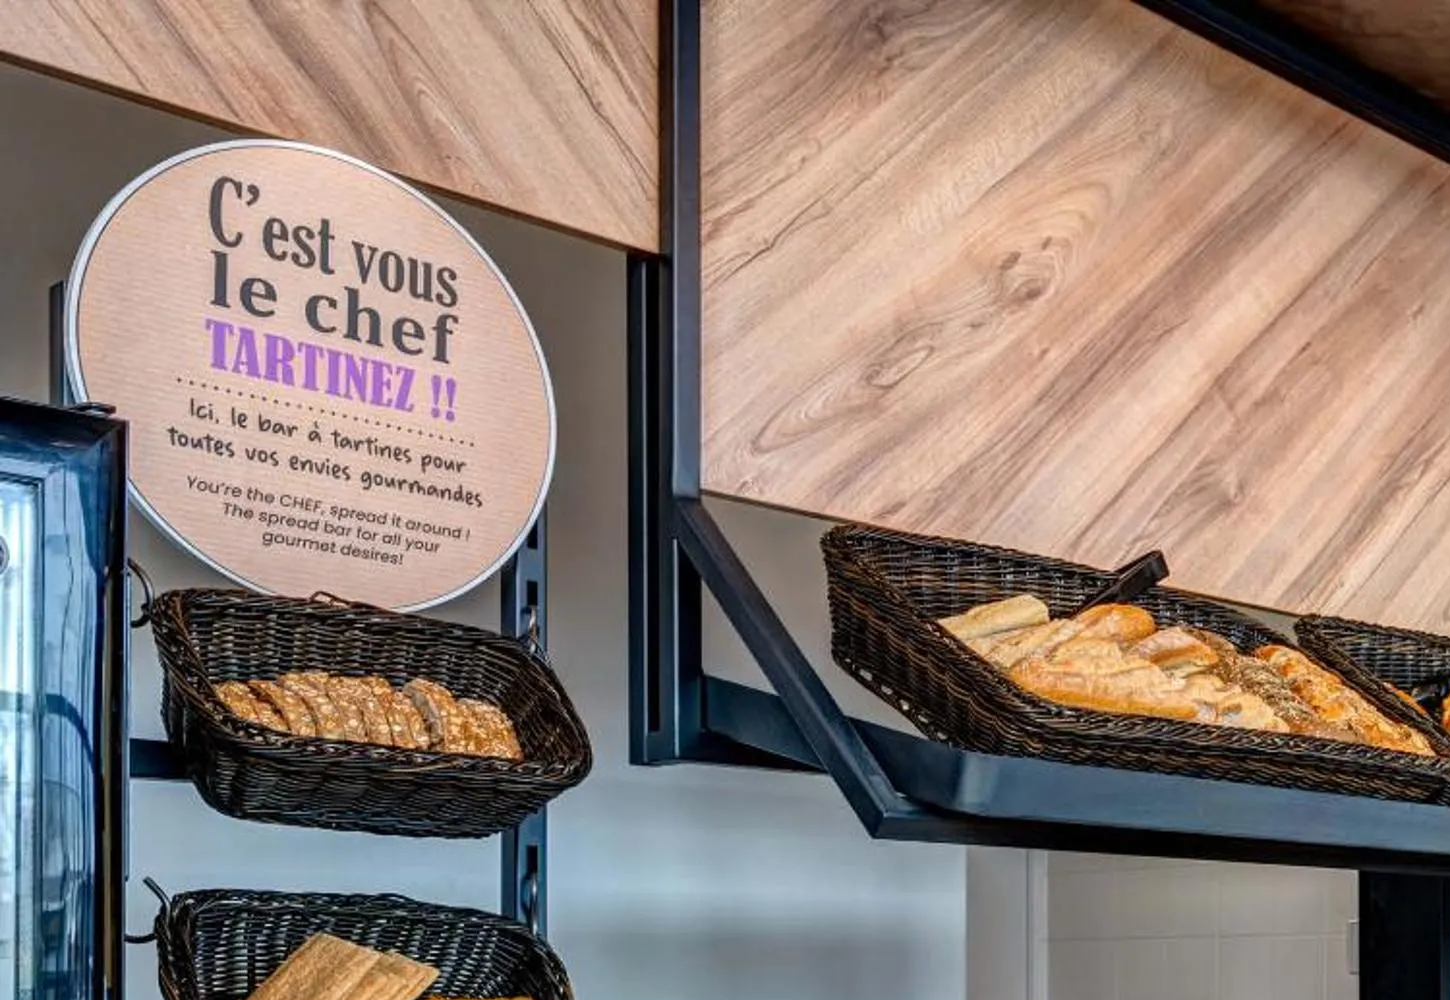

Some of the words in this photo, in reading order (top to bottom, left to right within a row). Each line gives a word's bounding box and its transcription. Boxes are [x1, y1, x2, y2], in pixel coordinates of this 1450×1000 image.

[209, 176, 335, 274] C'est
[352, 241, 458, 307] vous
[210, 250, 278, 317] le
[305, 286, 459, 364] chef
[205, 318, 416, 412] TARTINEZ
[431, 375, 456, 422] !!
[167, 426, 235, 458] toutes
[245, 448, 279, 467] vos
[289, 455, 350, 481] envies
[361, 471, 483, 507] gourmandes
[231, 407, 248, 428] le
[258, 414, 298, 437] bar
[309, 421, 321, 442] à
[331, 430, 412, 464] tartines
[421, 455, 466, 473] pour
[187, 475, 242, 497] You're
[247, 488, 275, 503] the
[330, 506, 387, 525] spread
[392, 513, 402, 527] it
[405, 520, 461, 538] around
[223, 502, 253, 519] The
[259, 511, 320, 532] spread
[324, 521, 351, 536] bar
[357, 526, 378, 541] for
[382, 532, 401, 546] all
[405, 537, 440, 553] your
[262, 532, 336, 554] gourmet
[340, 543, 404, 565] desires!
